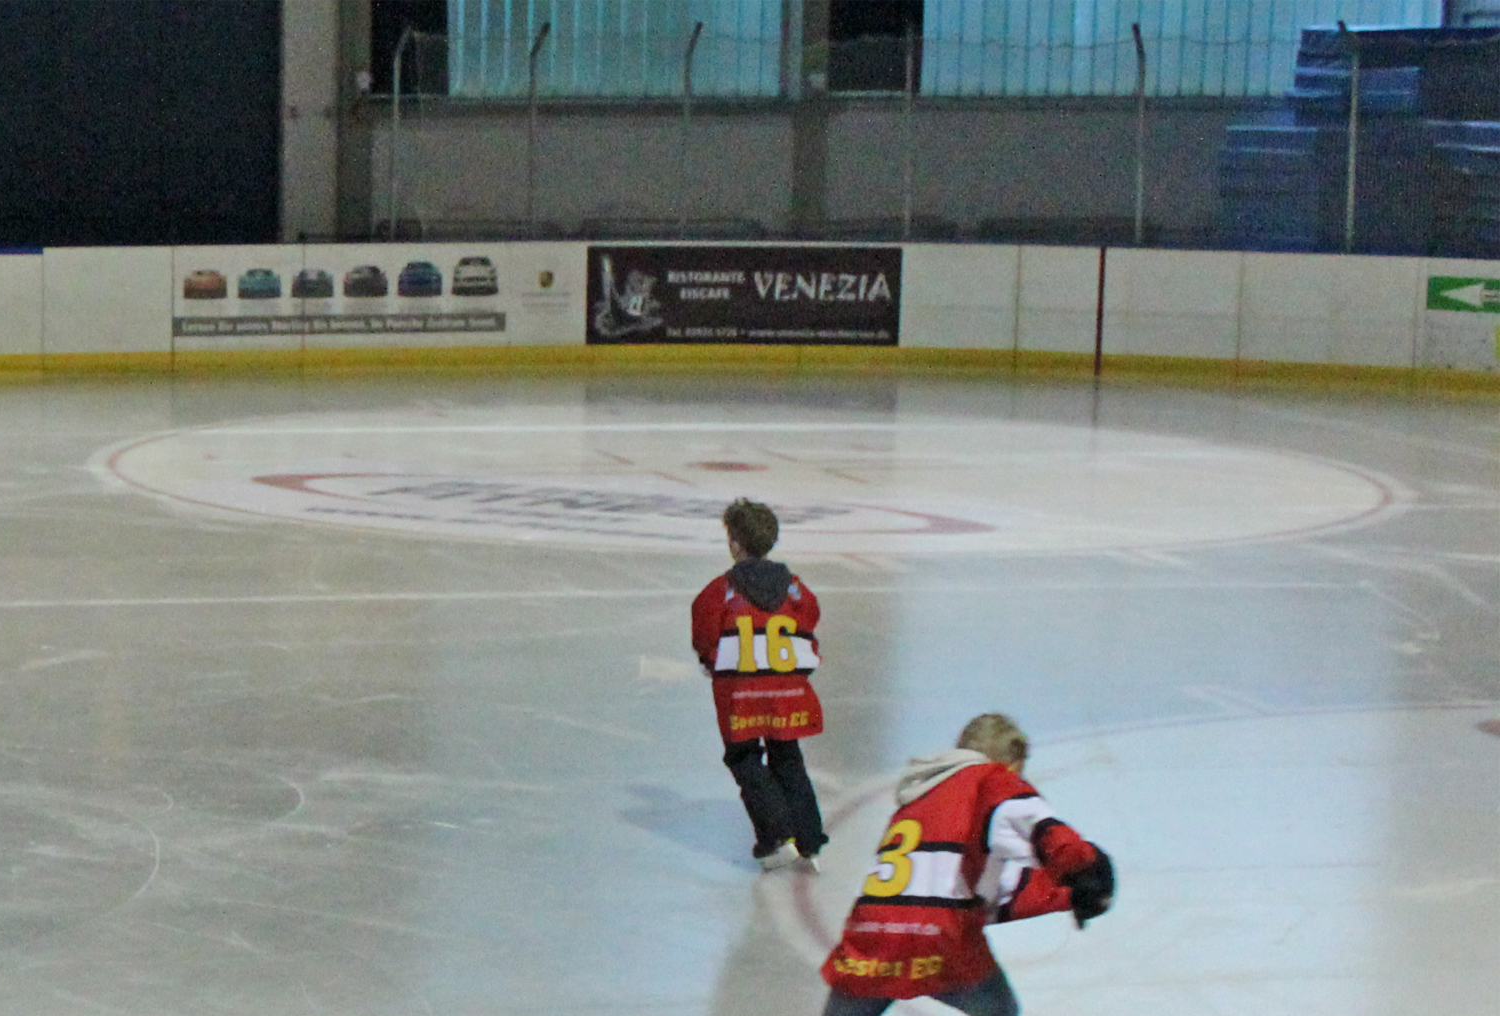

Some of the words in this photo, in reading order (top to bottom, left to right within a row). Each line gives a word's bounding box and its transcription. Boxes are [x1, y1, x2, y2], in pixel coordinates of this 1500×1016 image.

[754, 270, 893, 301] VENEZIA
[736, 615, 798, 673] 16
[862, 818, 923, 897] 3
